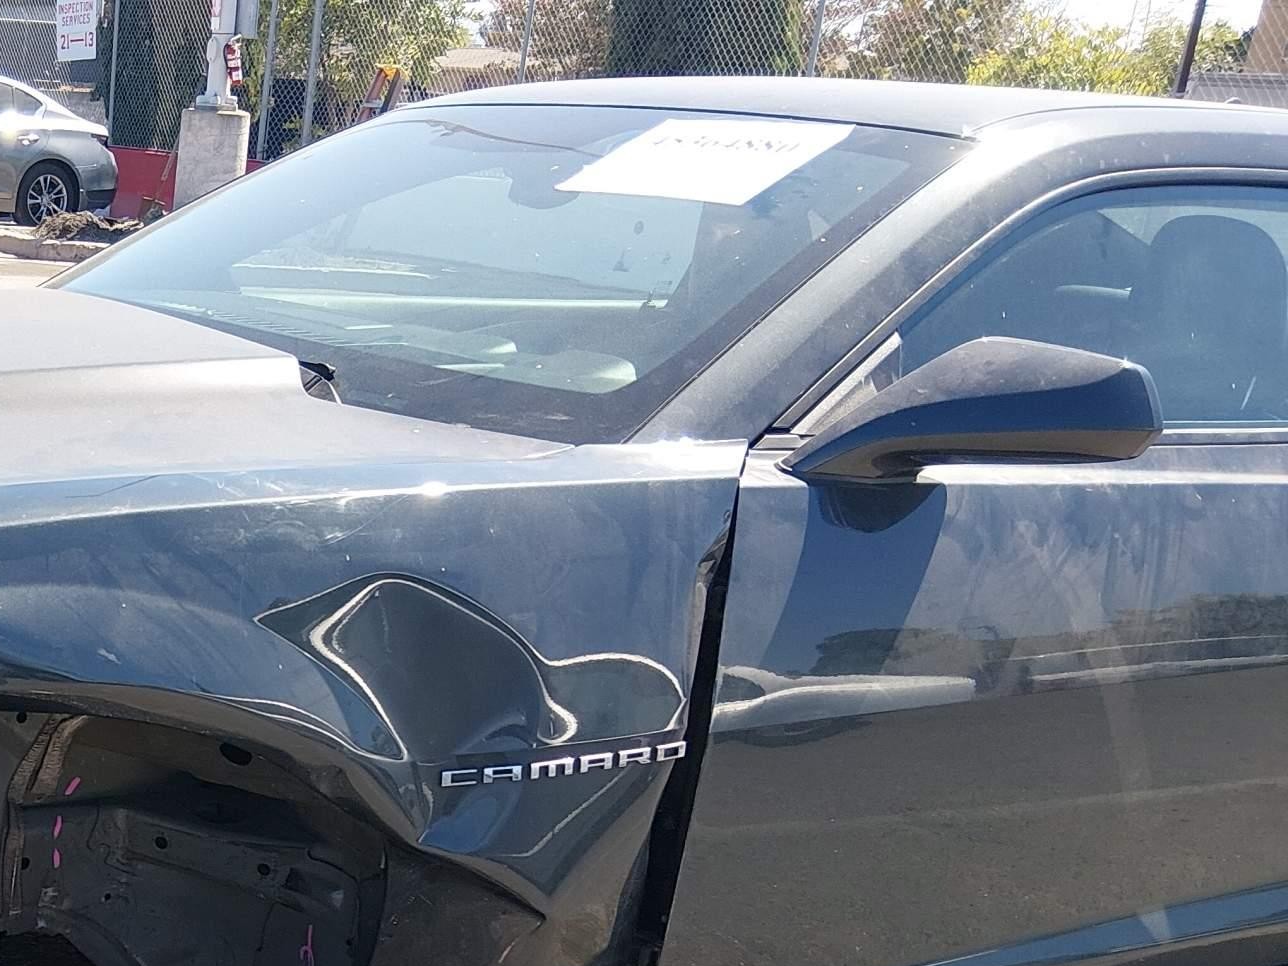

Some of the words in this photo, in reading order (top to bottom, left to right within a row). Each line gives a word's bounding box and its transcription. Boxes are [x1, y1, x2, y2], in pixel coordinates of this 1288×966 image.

[58, 2, 93, 14] INSPECTION
[62, 13, 90, 26] SERVICES
[441, 741, 687, 787] CAMARO
